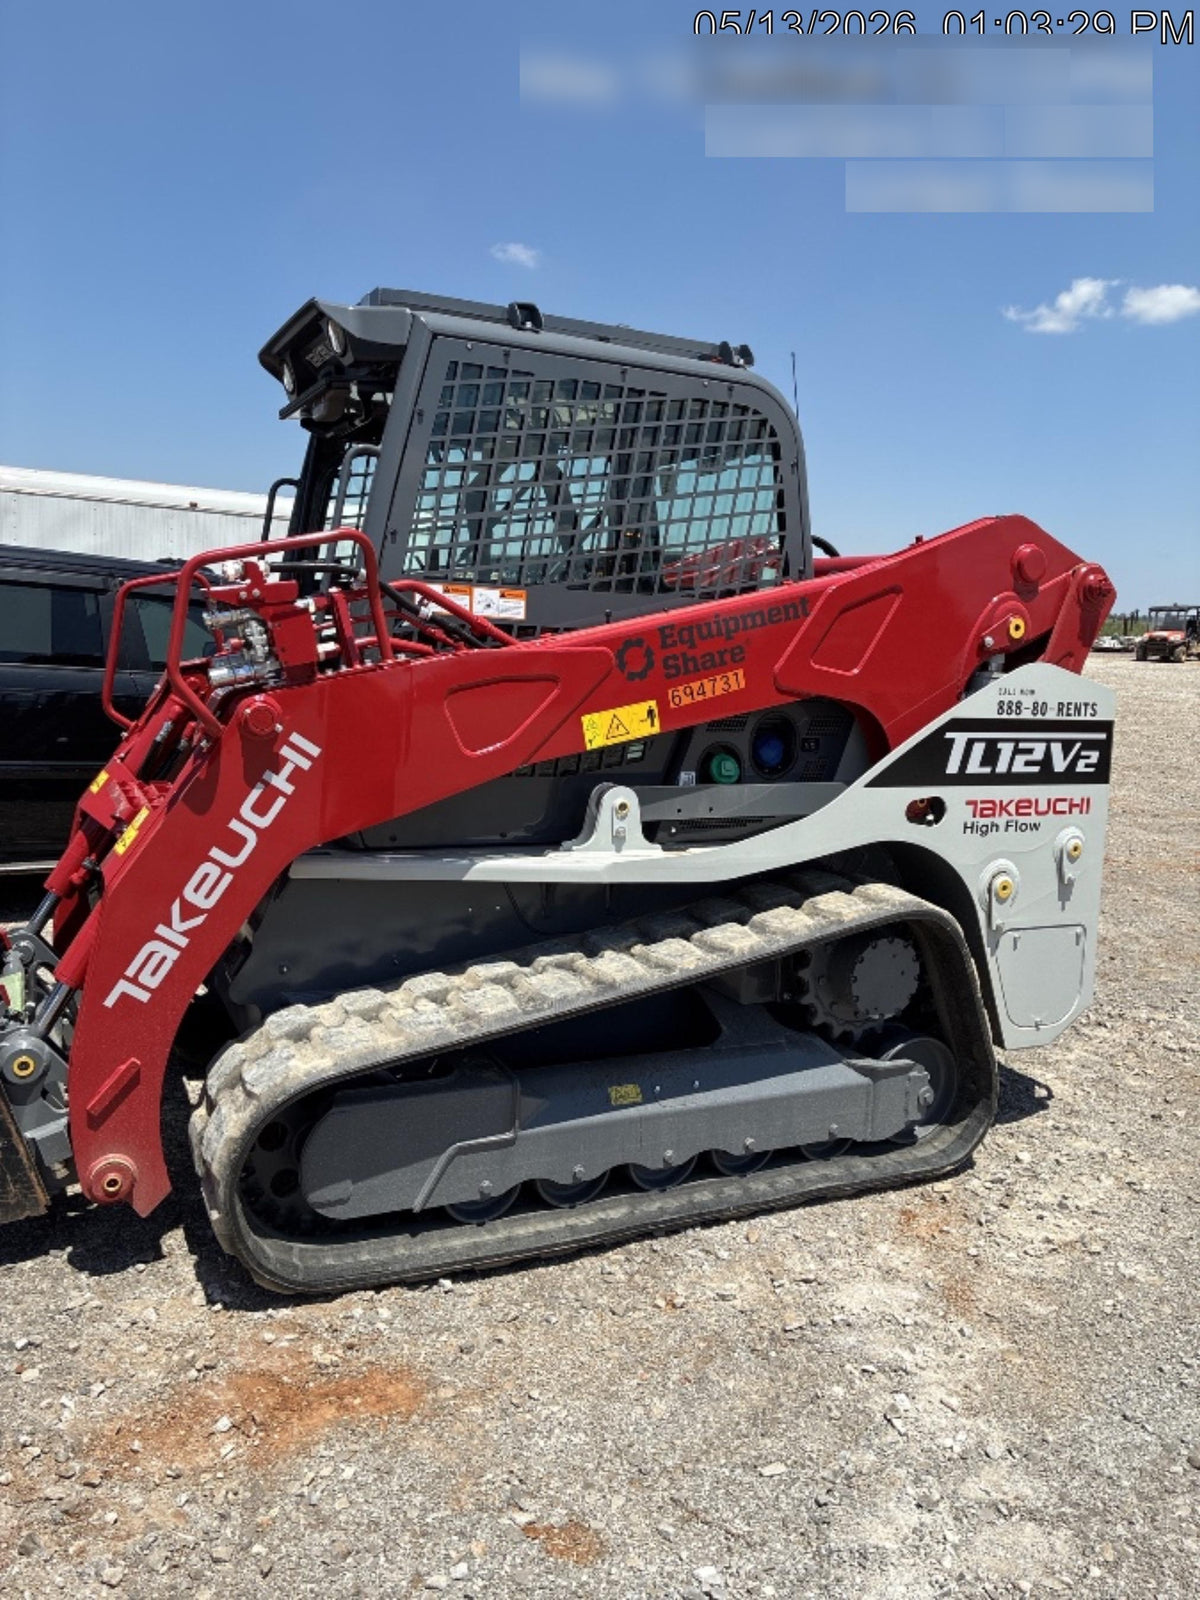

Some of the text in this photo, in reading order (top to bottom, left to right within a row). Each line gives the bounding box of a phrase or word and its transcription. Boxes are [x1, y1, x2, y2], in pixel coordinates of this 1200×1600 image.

[657, 596, 810, 649] Equipment
[662, 644, 746, 680] Share
[670, 671, 744, 707] 694731
[963, 820, 1042, 838] High Flow
